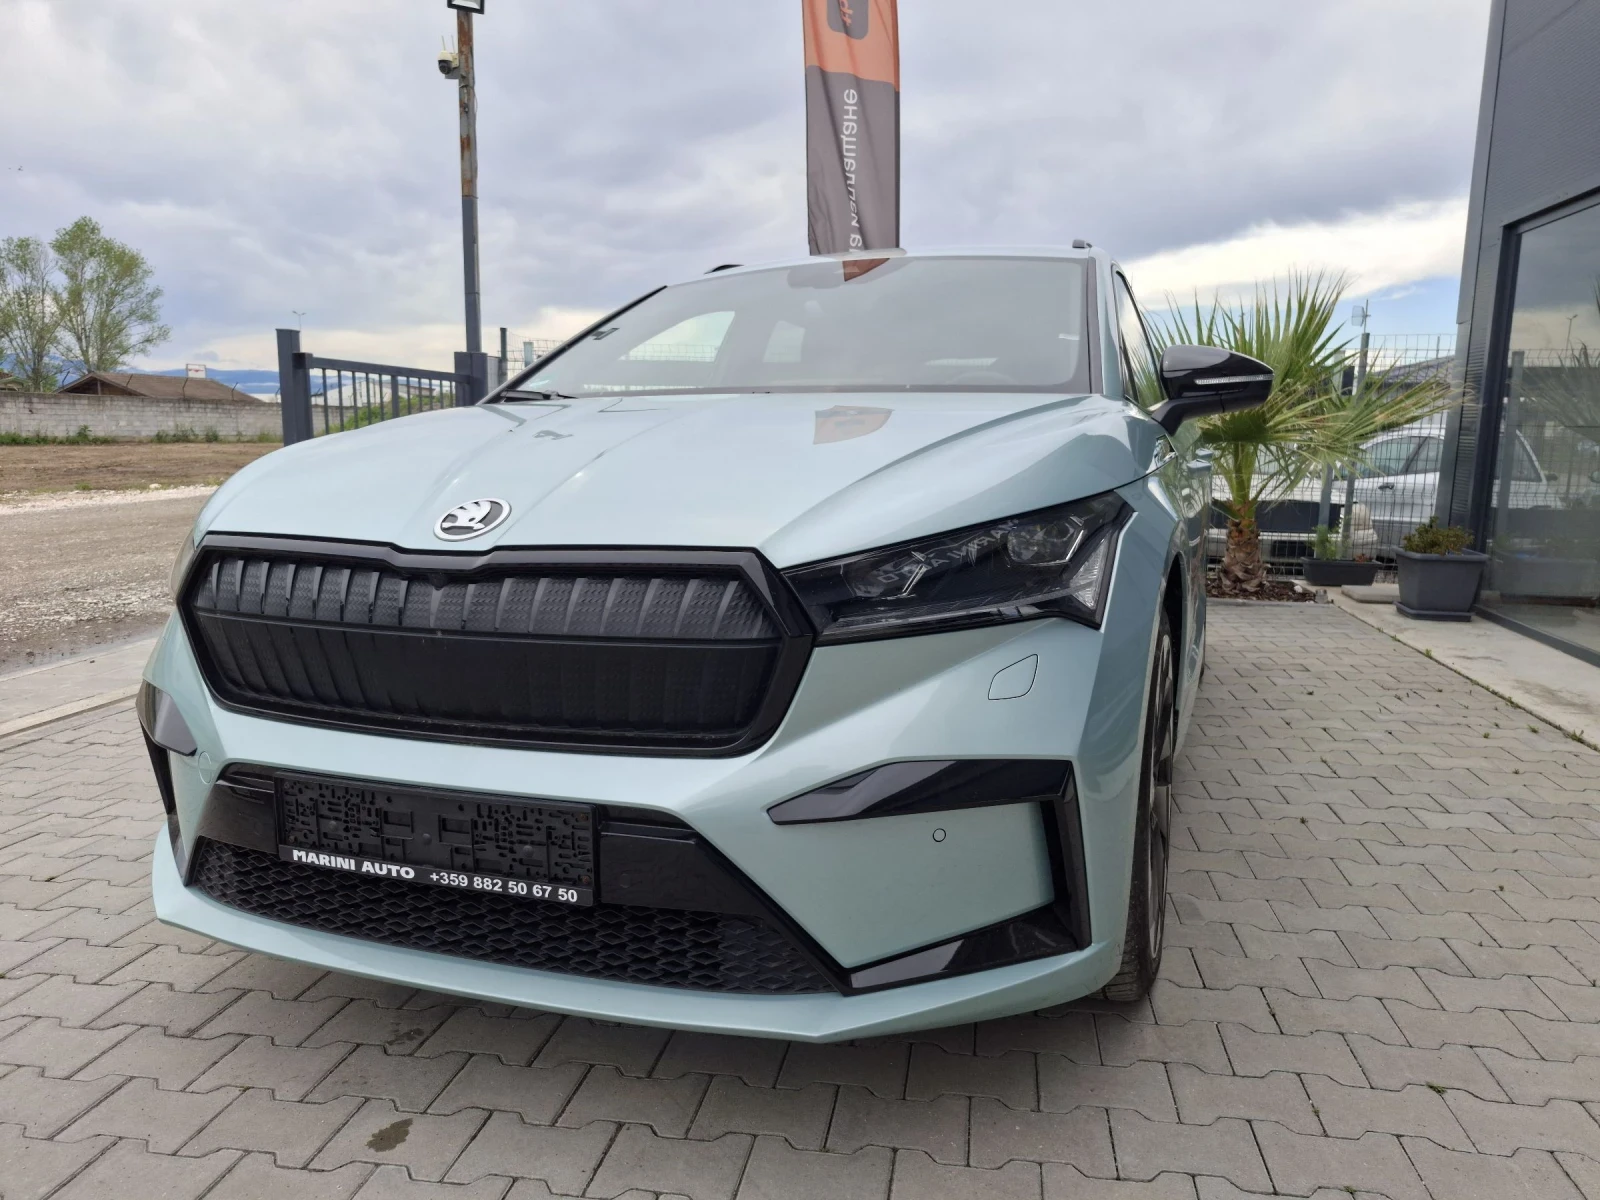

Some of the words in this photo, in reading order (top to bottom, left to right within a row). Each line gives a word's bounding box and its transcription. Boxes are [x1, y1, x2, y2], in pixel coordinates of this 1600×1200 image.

[293, 849, 356, 871] MARINI
[361, 861, 415, 879] AUTO
[430, 872, 468, 887] +359
[473, 876, 502, 891] 882
[508, 881, 527, 895] 50
[532, 885, 552, 898] 67
[558, 888, 578, 903] 50
